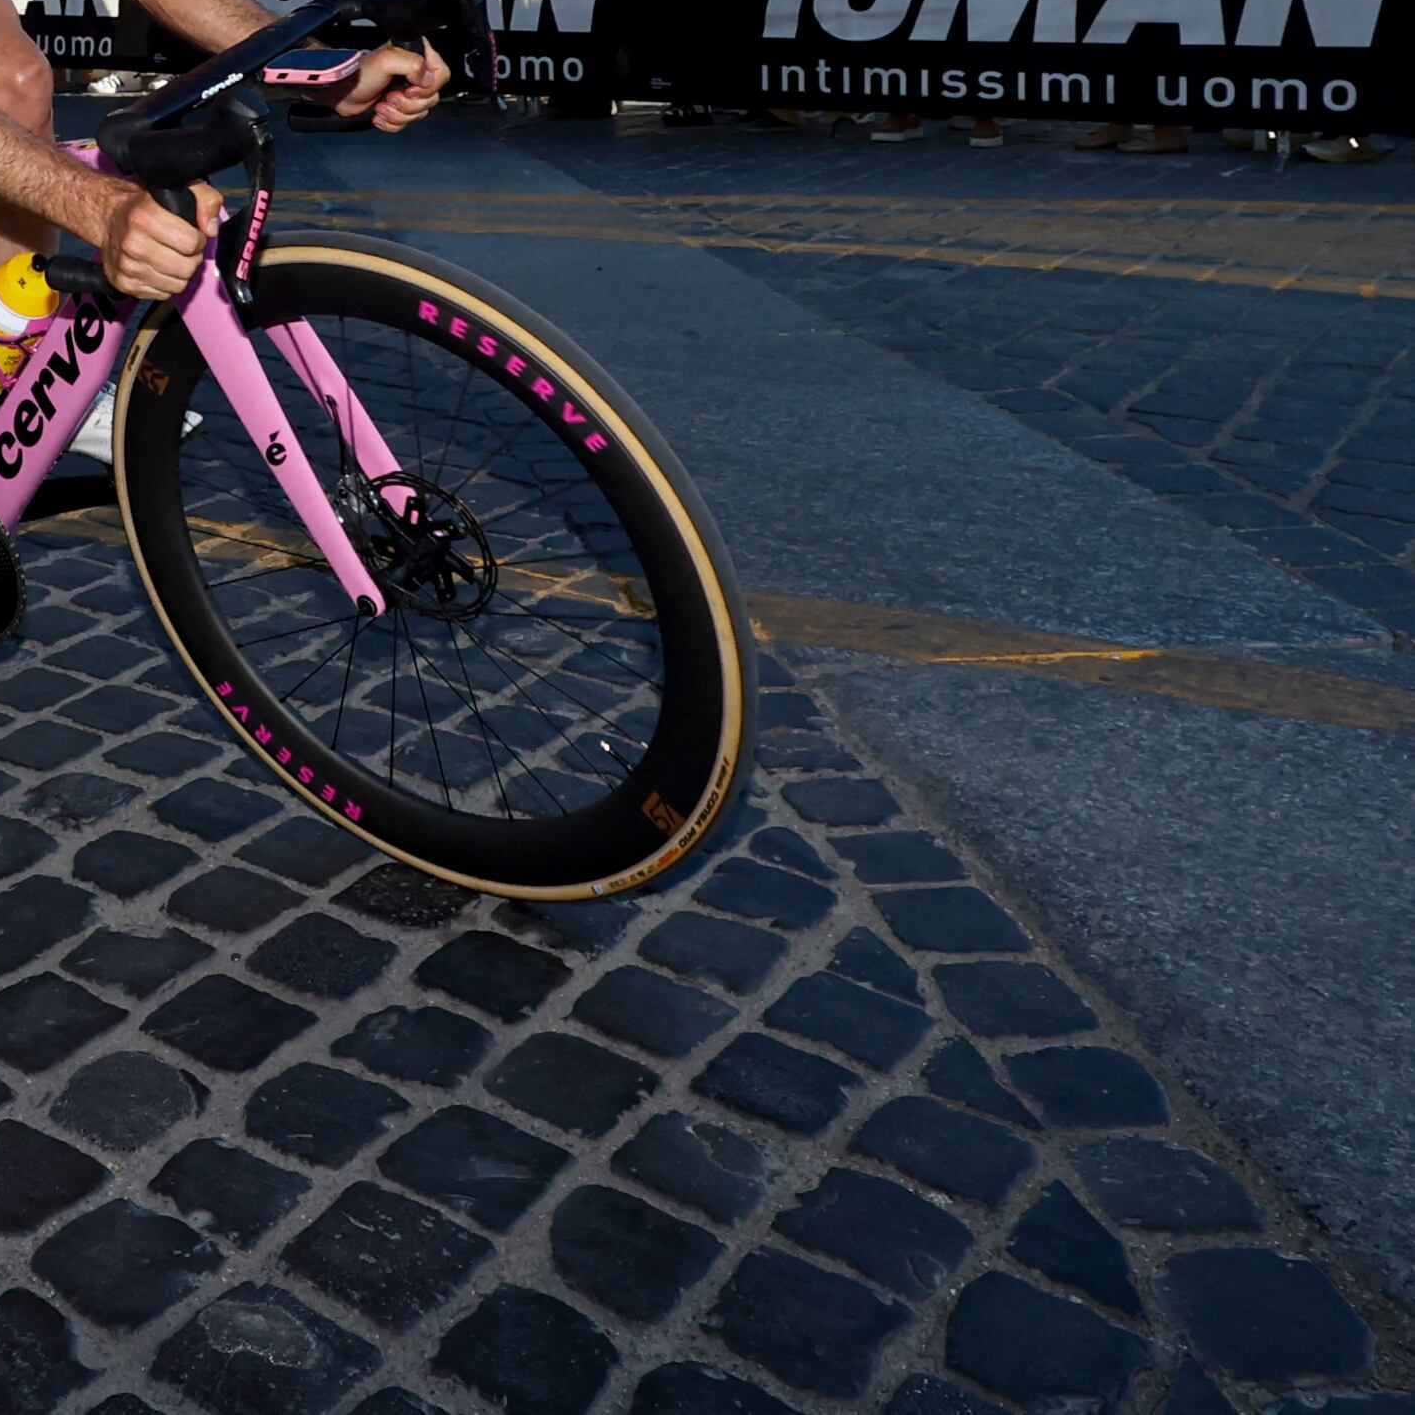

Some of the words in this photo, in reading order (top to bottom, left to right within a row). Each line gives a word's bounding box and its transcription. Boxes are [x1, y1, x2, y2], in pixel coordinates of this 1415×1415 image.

[761, 58, 1115, 104] intimissimi
[1157, 74, 1358, 113] uomo
[235, 189, 270, 282] SRAM
[417, 299, 609, 453] RESERVE
[215, 681, 363, 822] RESERVE
